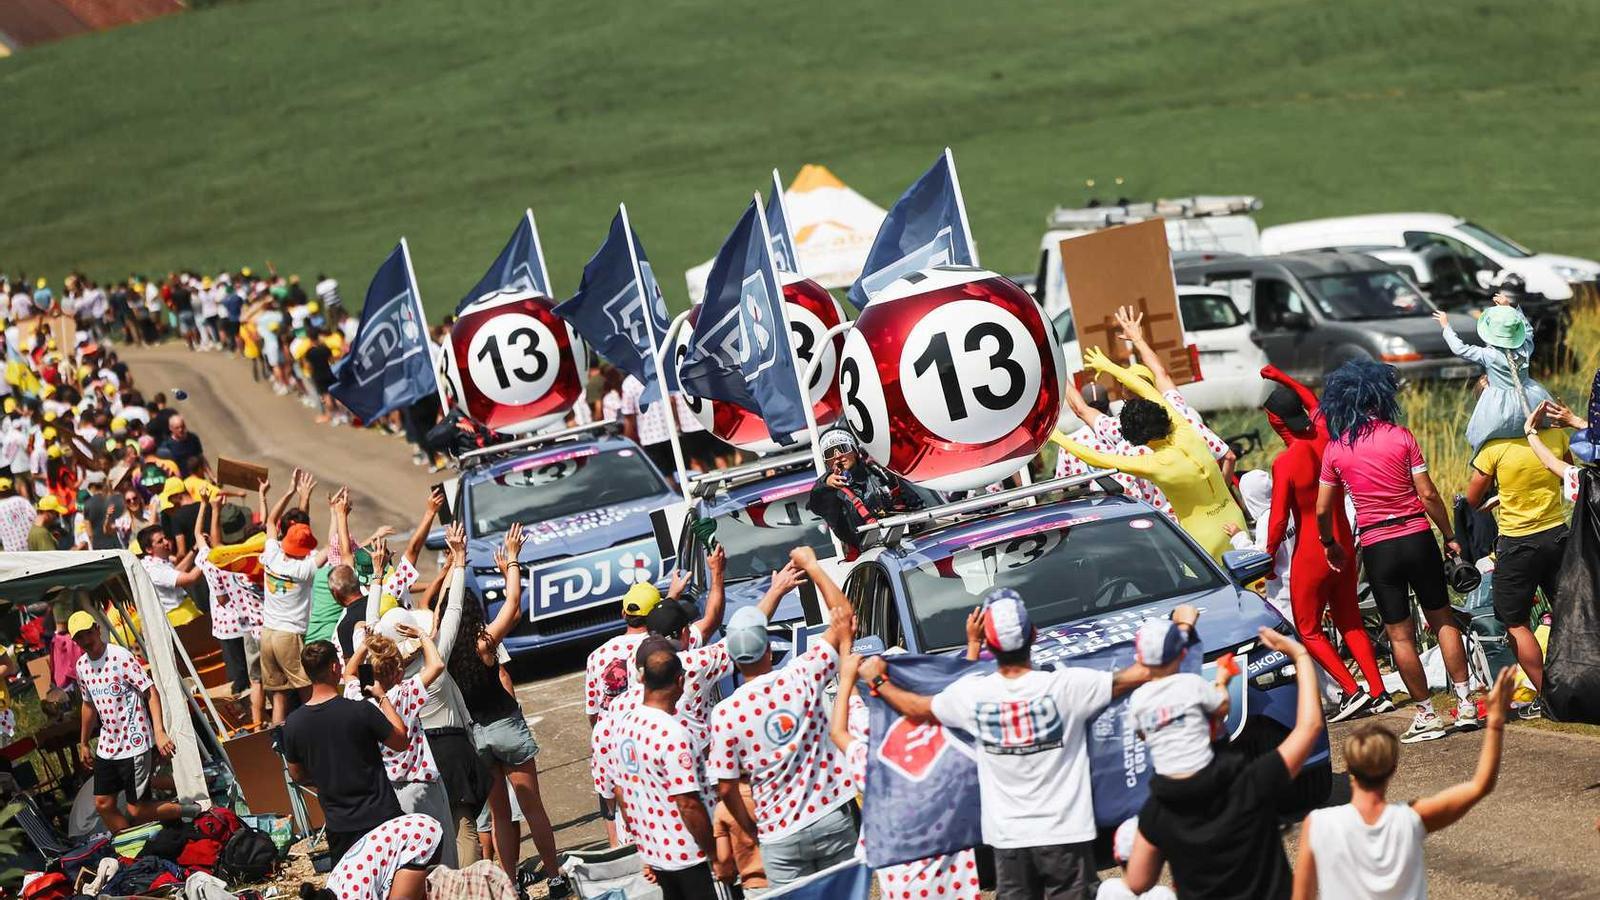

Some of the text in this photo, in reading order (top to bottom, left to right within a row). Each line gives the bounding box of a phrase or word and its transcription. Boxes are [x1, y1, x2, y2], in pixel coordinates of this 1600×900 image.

[477, 327, 548, 390] 13
[790, 320, 823, 391] 3
[913, 321, 1027, 422] 13
[840, 356, 875, 444] 3
[540, 560, 612, 608] FDJ
[1247, 651, 1285, 673] SKOD
